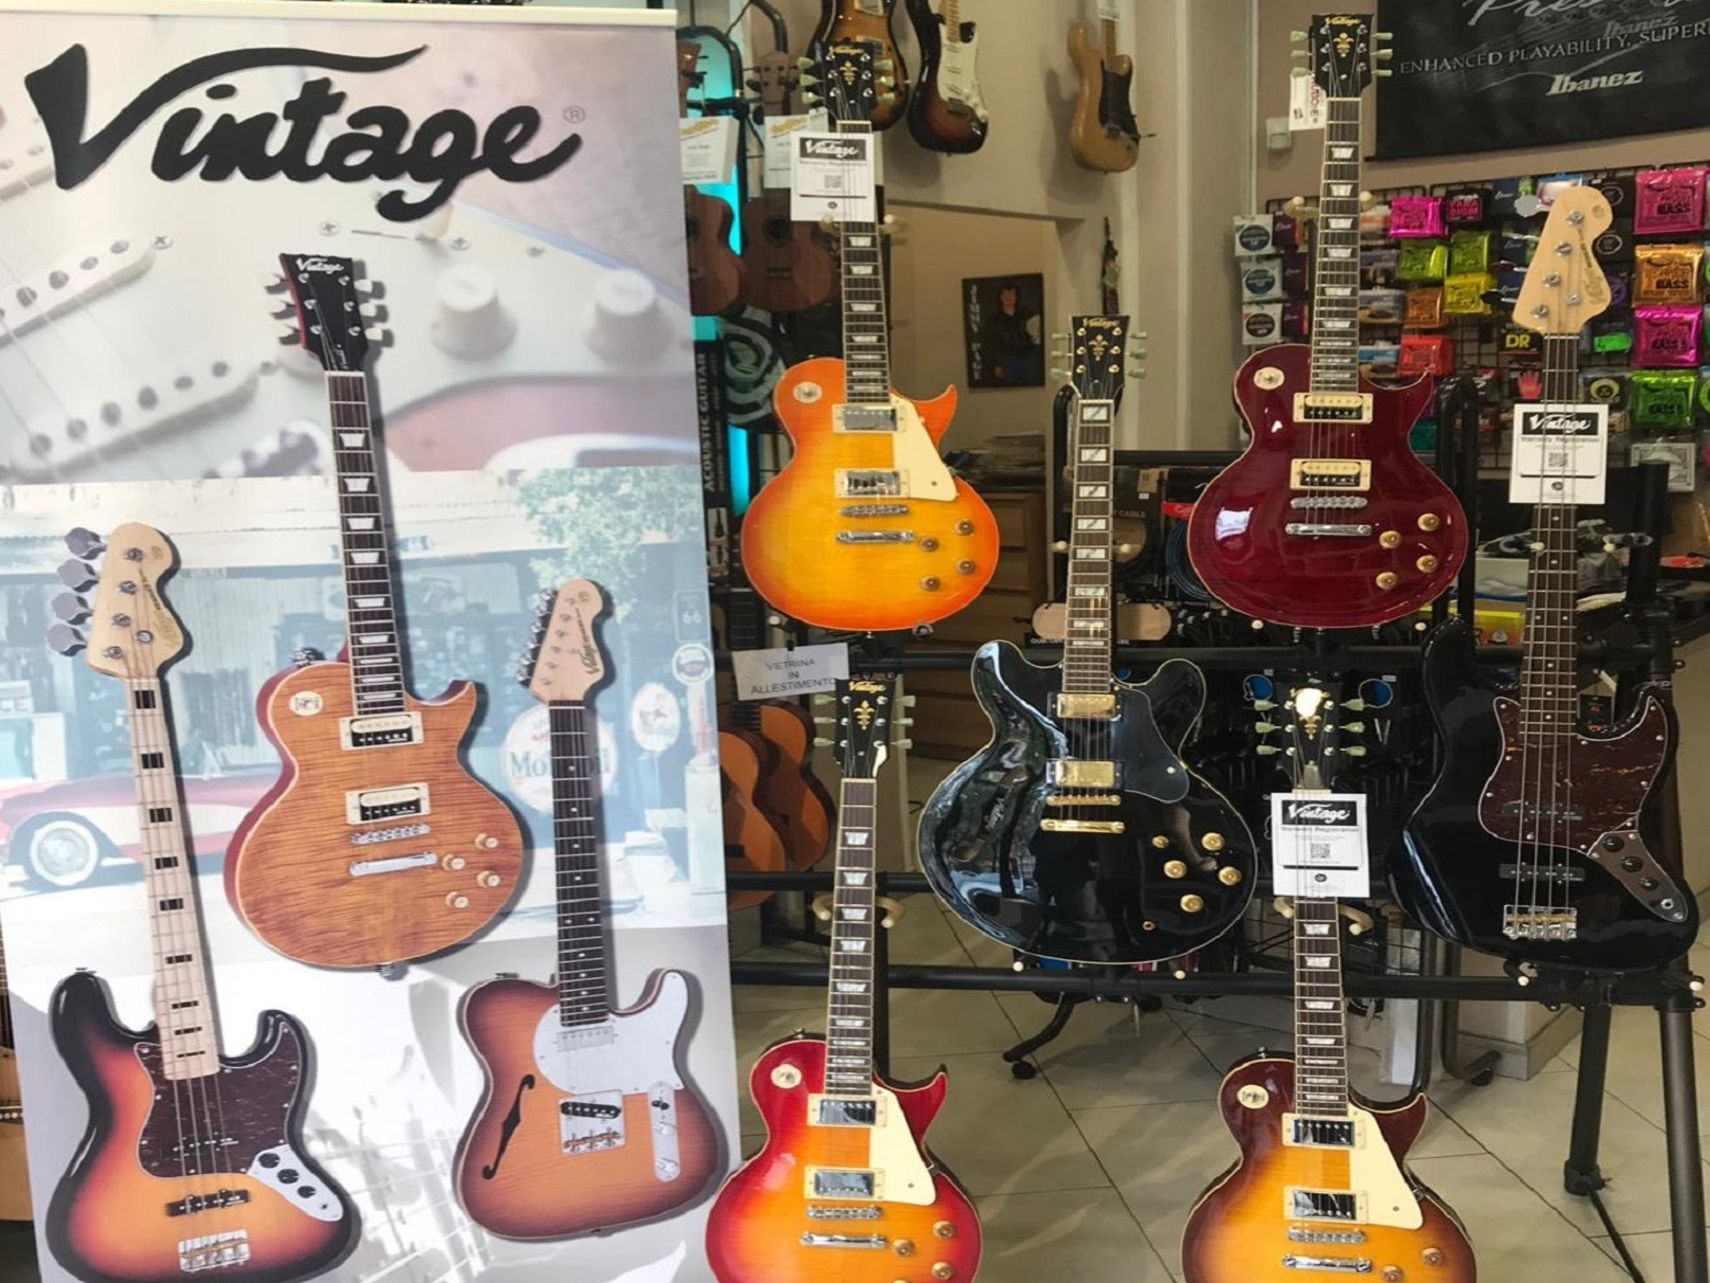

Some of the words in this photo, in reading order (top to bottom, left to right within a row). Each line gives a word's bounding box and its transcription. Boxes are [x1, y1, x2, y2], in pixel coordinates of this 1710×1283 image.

[1400, 52, 1503, 75] ENHANCED
[1509, 36, 1632, 64] PLAYABILITY,
[1546, 69, 1644, 95] Ibanez
[24, 43, 582, 221] Vintage
[805, 140, 859, 158] Vintage
[296, 258, 344, 274] Vintage
[1505, 334, 1530, 348] DR
[1529, 413, 1591, 433] Vintage
[765, 658, 816, 671] VETRINA
[787, 671, 799, 679] IN
[751, 677, 836, 694] ALLESTIMENTO
[1288, 803, 1350, 823] Vintage
